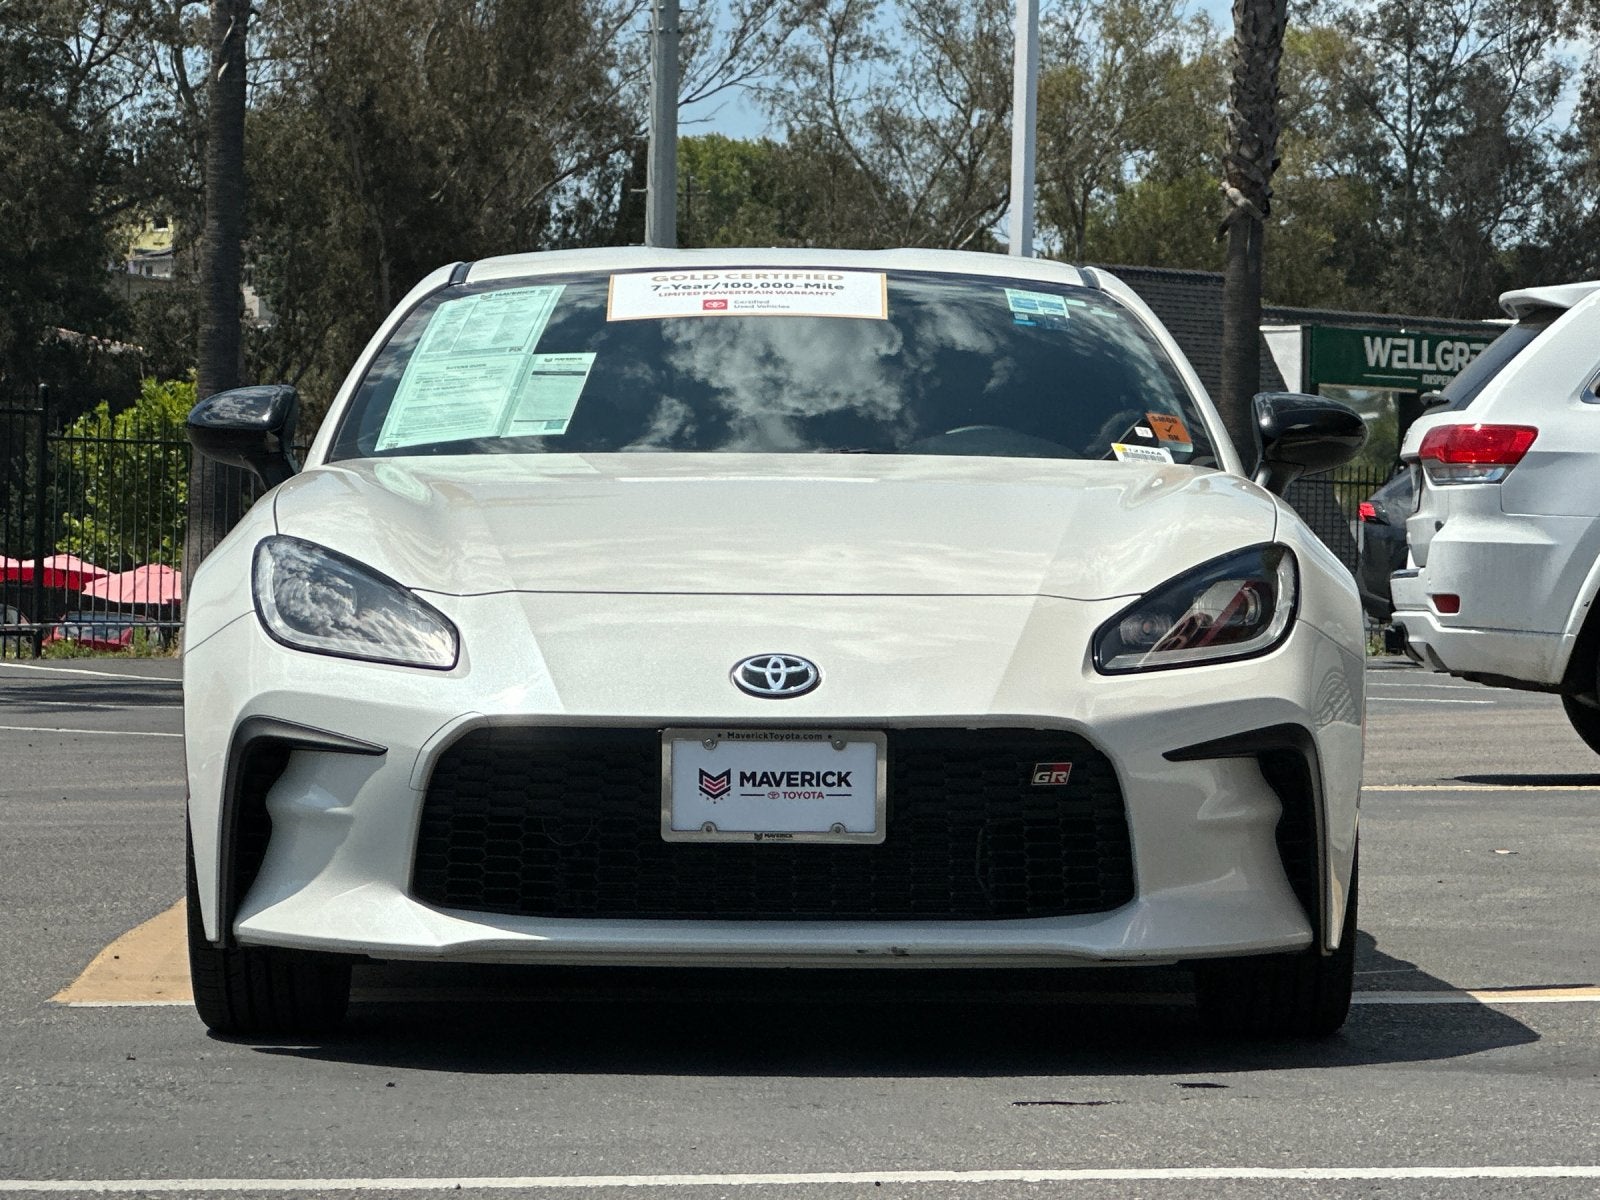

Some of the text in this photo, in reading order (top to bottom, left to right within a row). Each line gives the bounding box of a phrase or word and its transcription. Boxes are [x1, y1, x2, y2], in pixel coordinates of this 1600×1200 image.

[651, 272, 844, 282] GOLD CERTIFIED
[651, 281, 845, 291] 7-Year/100,000-Mile
[726, 731, 823, 741] MaverickToyota.com
[739, 771, 852, 788] MAVERICK
[1033, 771, 1068, 783] GR
[782, 791, 824, 800] TOYOTA
